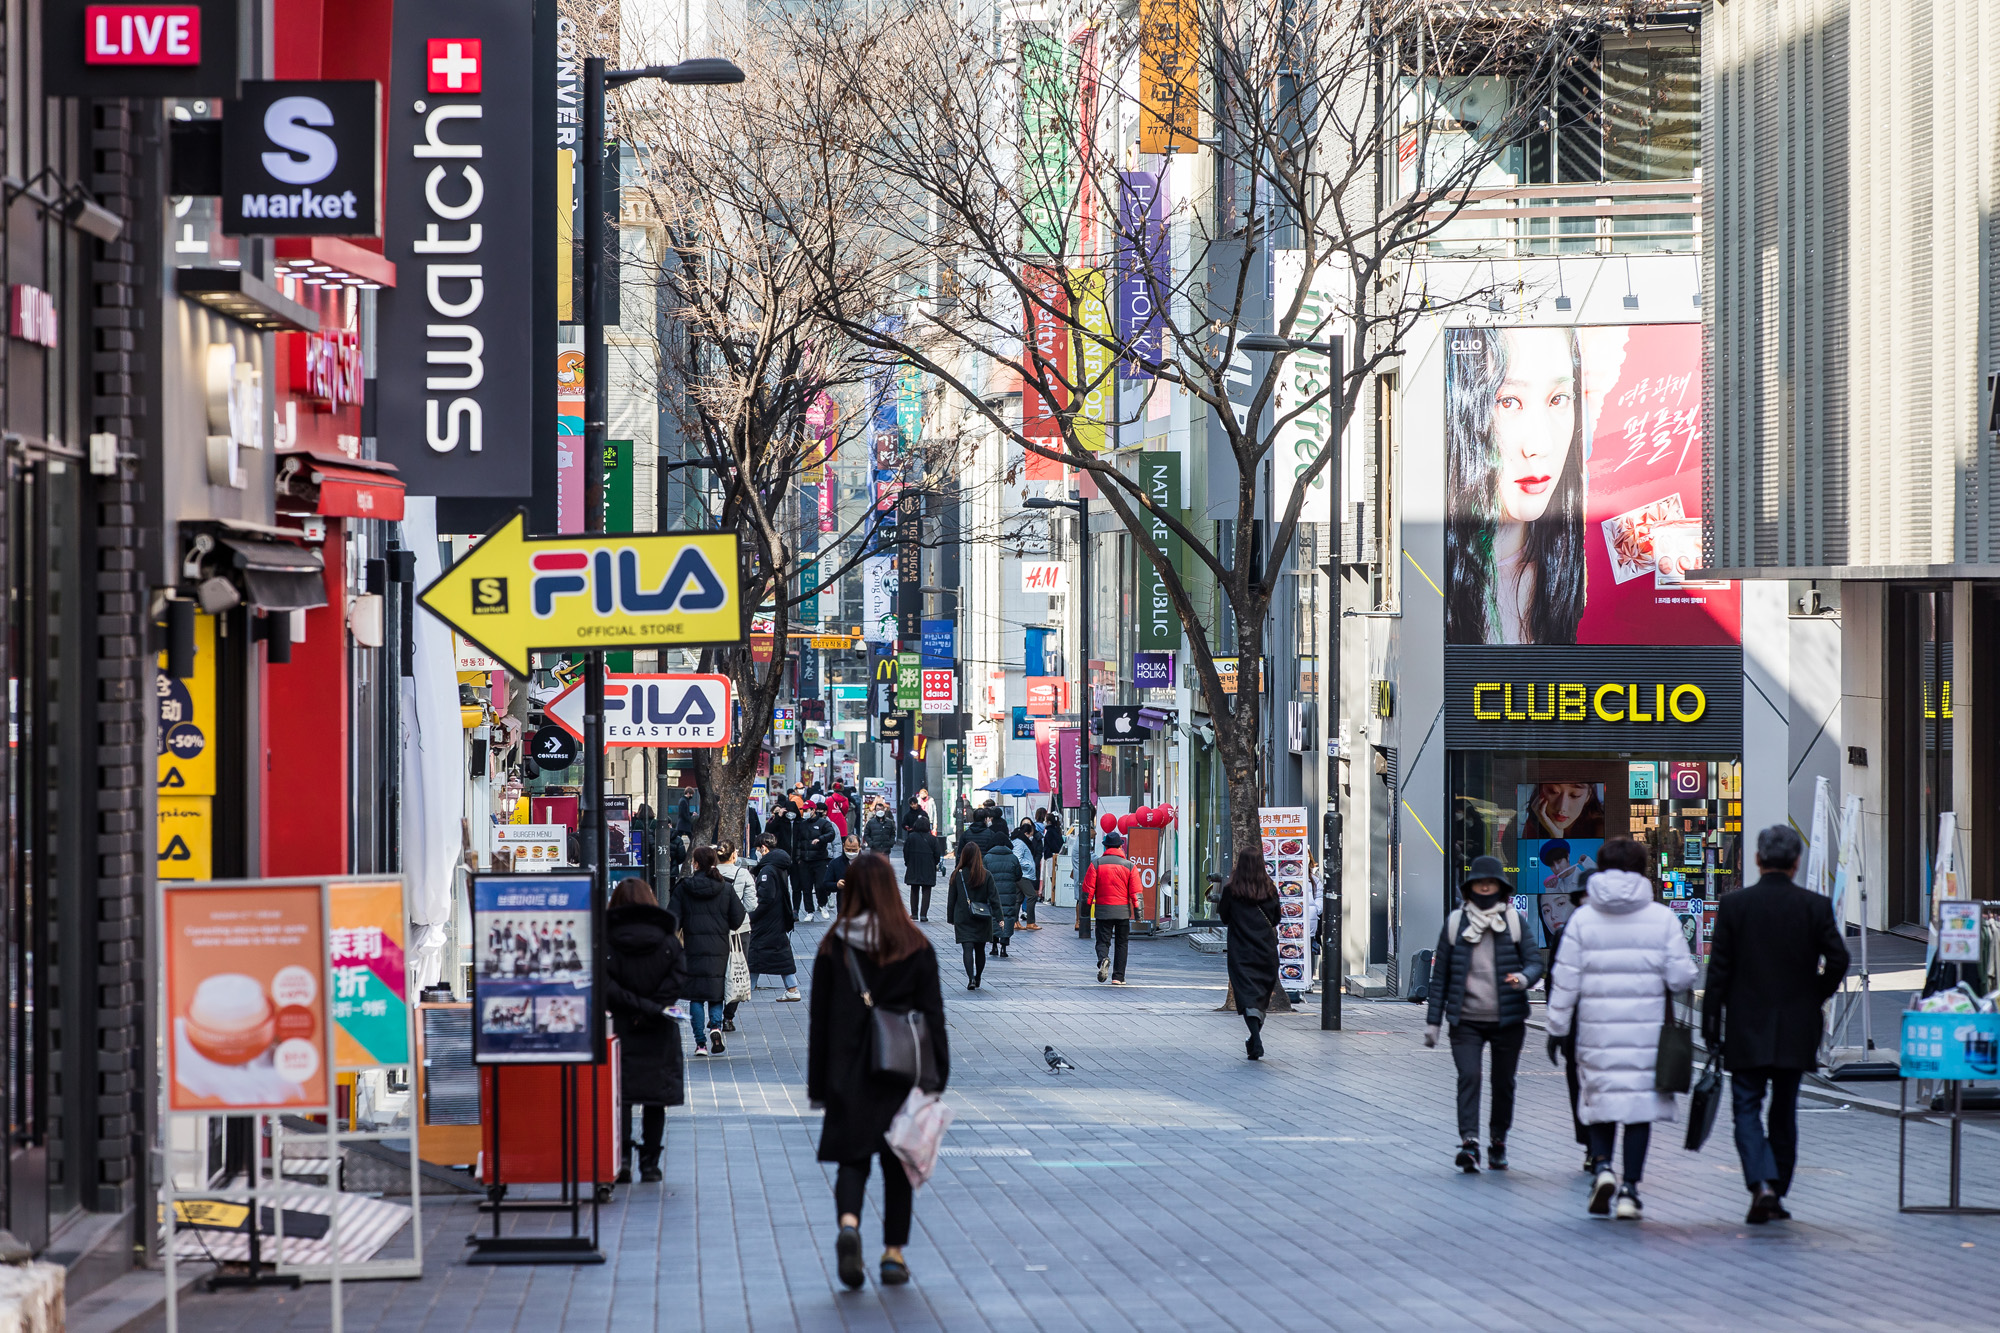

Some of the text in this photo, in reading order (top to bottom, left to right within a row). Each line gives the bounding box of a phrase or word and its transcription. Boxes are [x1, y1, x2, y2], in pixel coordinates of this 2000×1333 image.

[96, 15, 190, 54] LIVE
[557, 17, 578, 186] CONVER
[261, 96, 338, 184] S
[241, 189, 358, 219] Market
[413, 103, 485, 454] swatch
[1451, 340, 1482, 350] CLIO
[1039, 374, 1058, 420] sin
[532, 547, 727, 616] FILA
[1026, 567, 1059, 588] H&M
[478, 579, 502, 605] S
[871, 564, 884, 614] Gong cha
[1153, 548, 1168, 637] RPUBLIC
[577, 623, 684, 637] OFFICIAL STORE
[461, 658, 485, 667] 명동점
[1137, 663, 1167, 671] HOLIKA
[1224, 663, 1239, 671] CN
[1137, 671, 1167, 679] HOLIKA
[926, 689, 950, 698] daiso
[604, 685, 716, 725] FILA
[609, 725, 715, 738] EGASTORE
[157, 808, 202, 823] pion
[1130, 857, 1154, 865] SALE
[1137, 868, 1156, 888] 0
[1515, 895, 1527, 910] 30
[1690, 899, 1703, 914] 30
